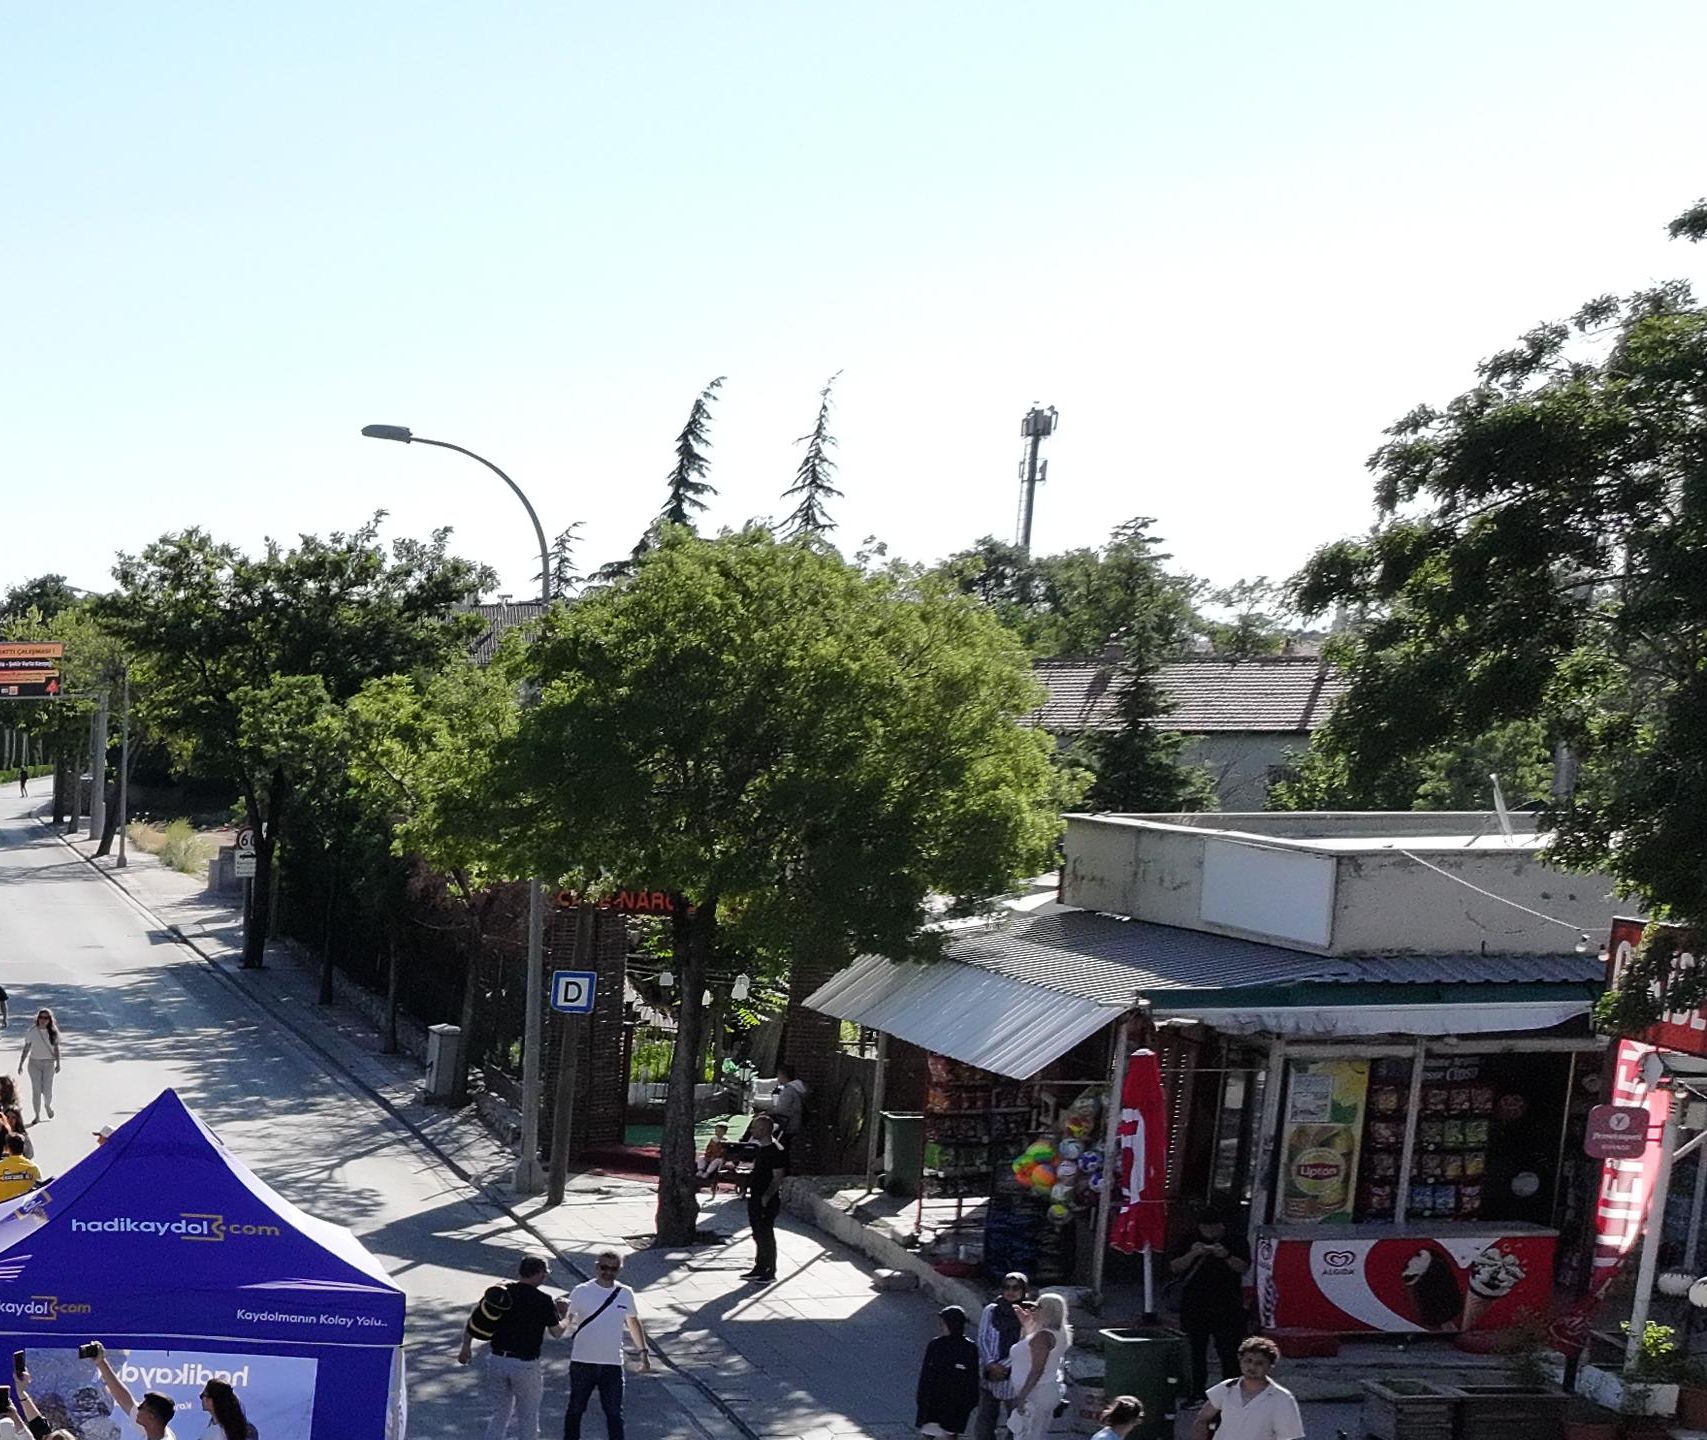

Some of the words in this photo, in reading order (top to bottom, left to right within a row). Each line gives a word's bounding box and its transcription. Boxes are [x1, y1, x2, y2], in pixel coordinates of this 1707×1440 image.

[563, 981, 582, 1003] D
[1300, 1165, 1338, 1178] Lipton
[236, 1309, 316, 1323] Kaydolmanın
[319, 1313, 354, 1328] Kolay
